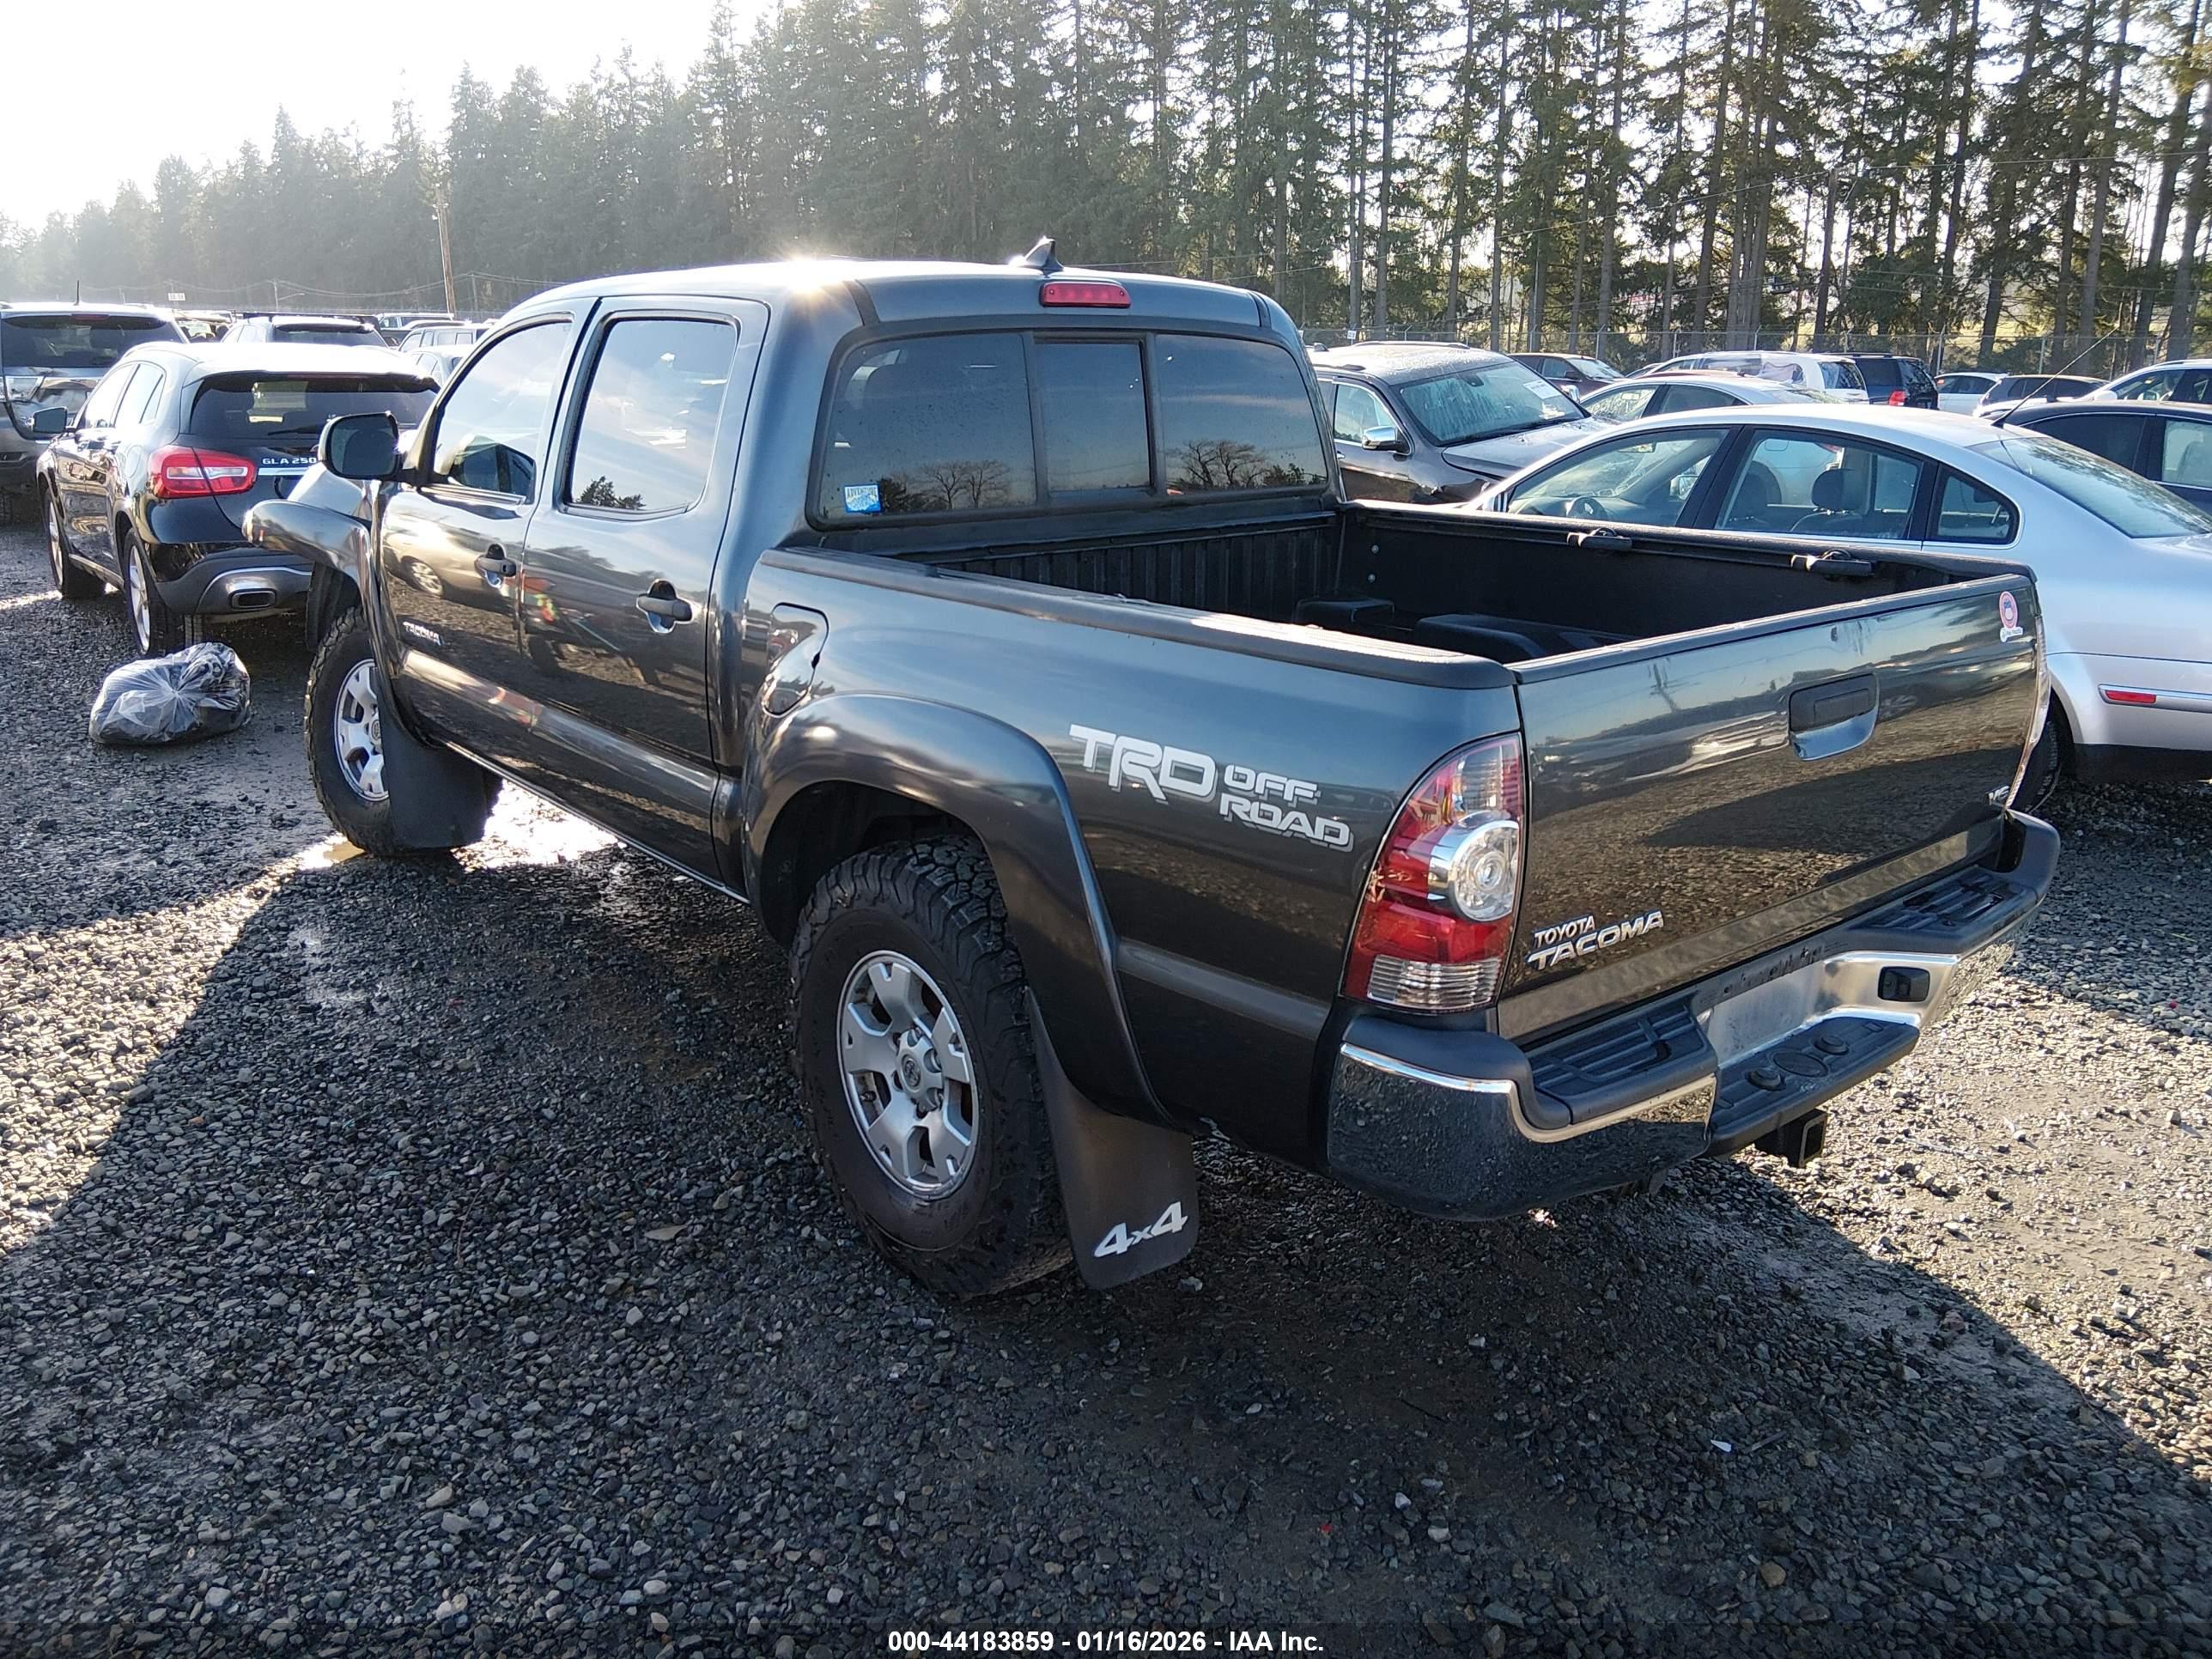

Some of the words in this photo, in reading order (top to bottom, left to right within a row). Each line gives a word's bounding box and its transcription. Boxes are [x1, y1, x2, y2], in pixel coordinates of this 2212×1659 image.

[1069, 724, 1218, 805] TRD
[1223, 763, 1322, 807] OFF
[1219, 793, 1353, 853] ROAD
[1527, 910, 1664, 970] TACOMA
[1534, 915, 1595, 948] TOYOTA
[1094, 1200, 1188, 1258] 4x4
